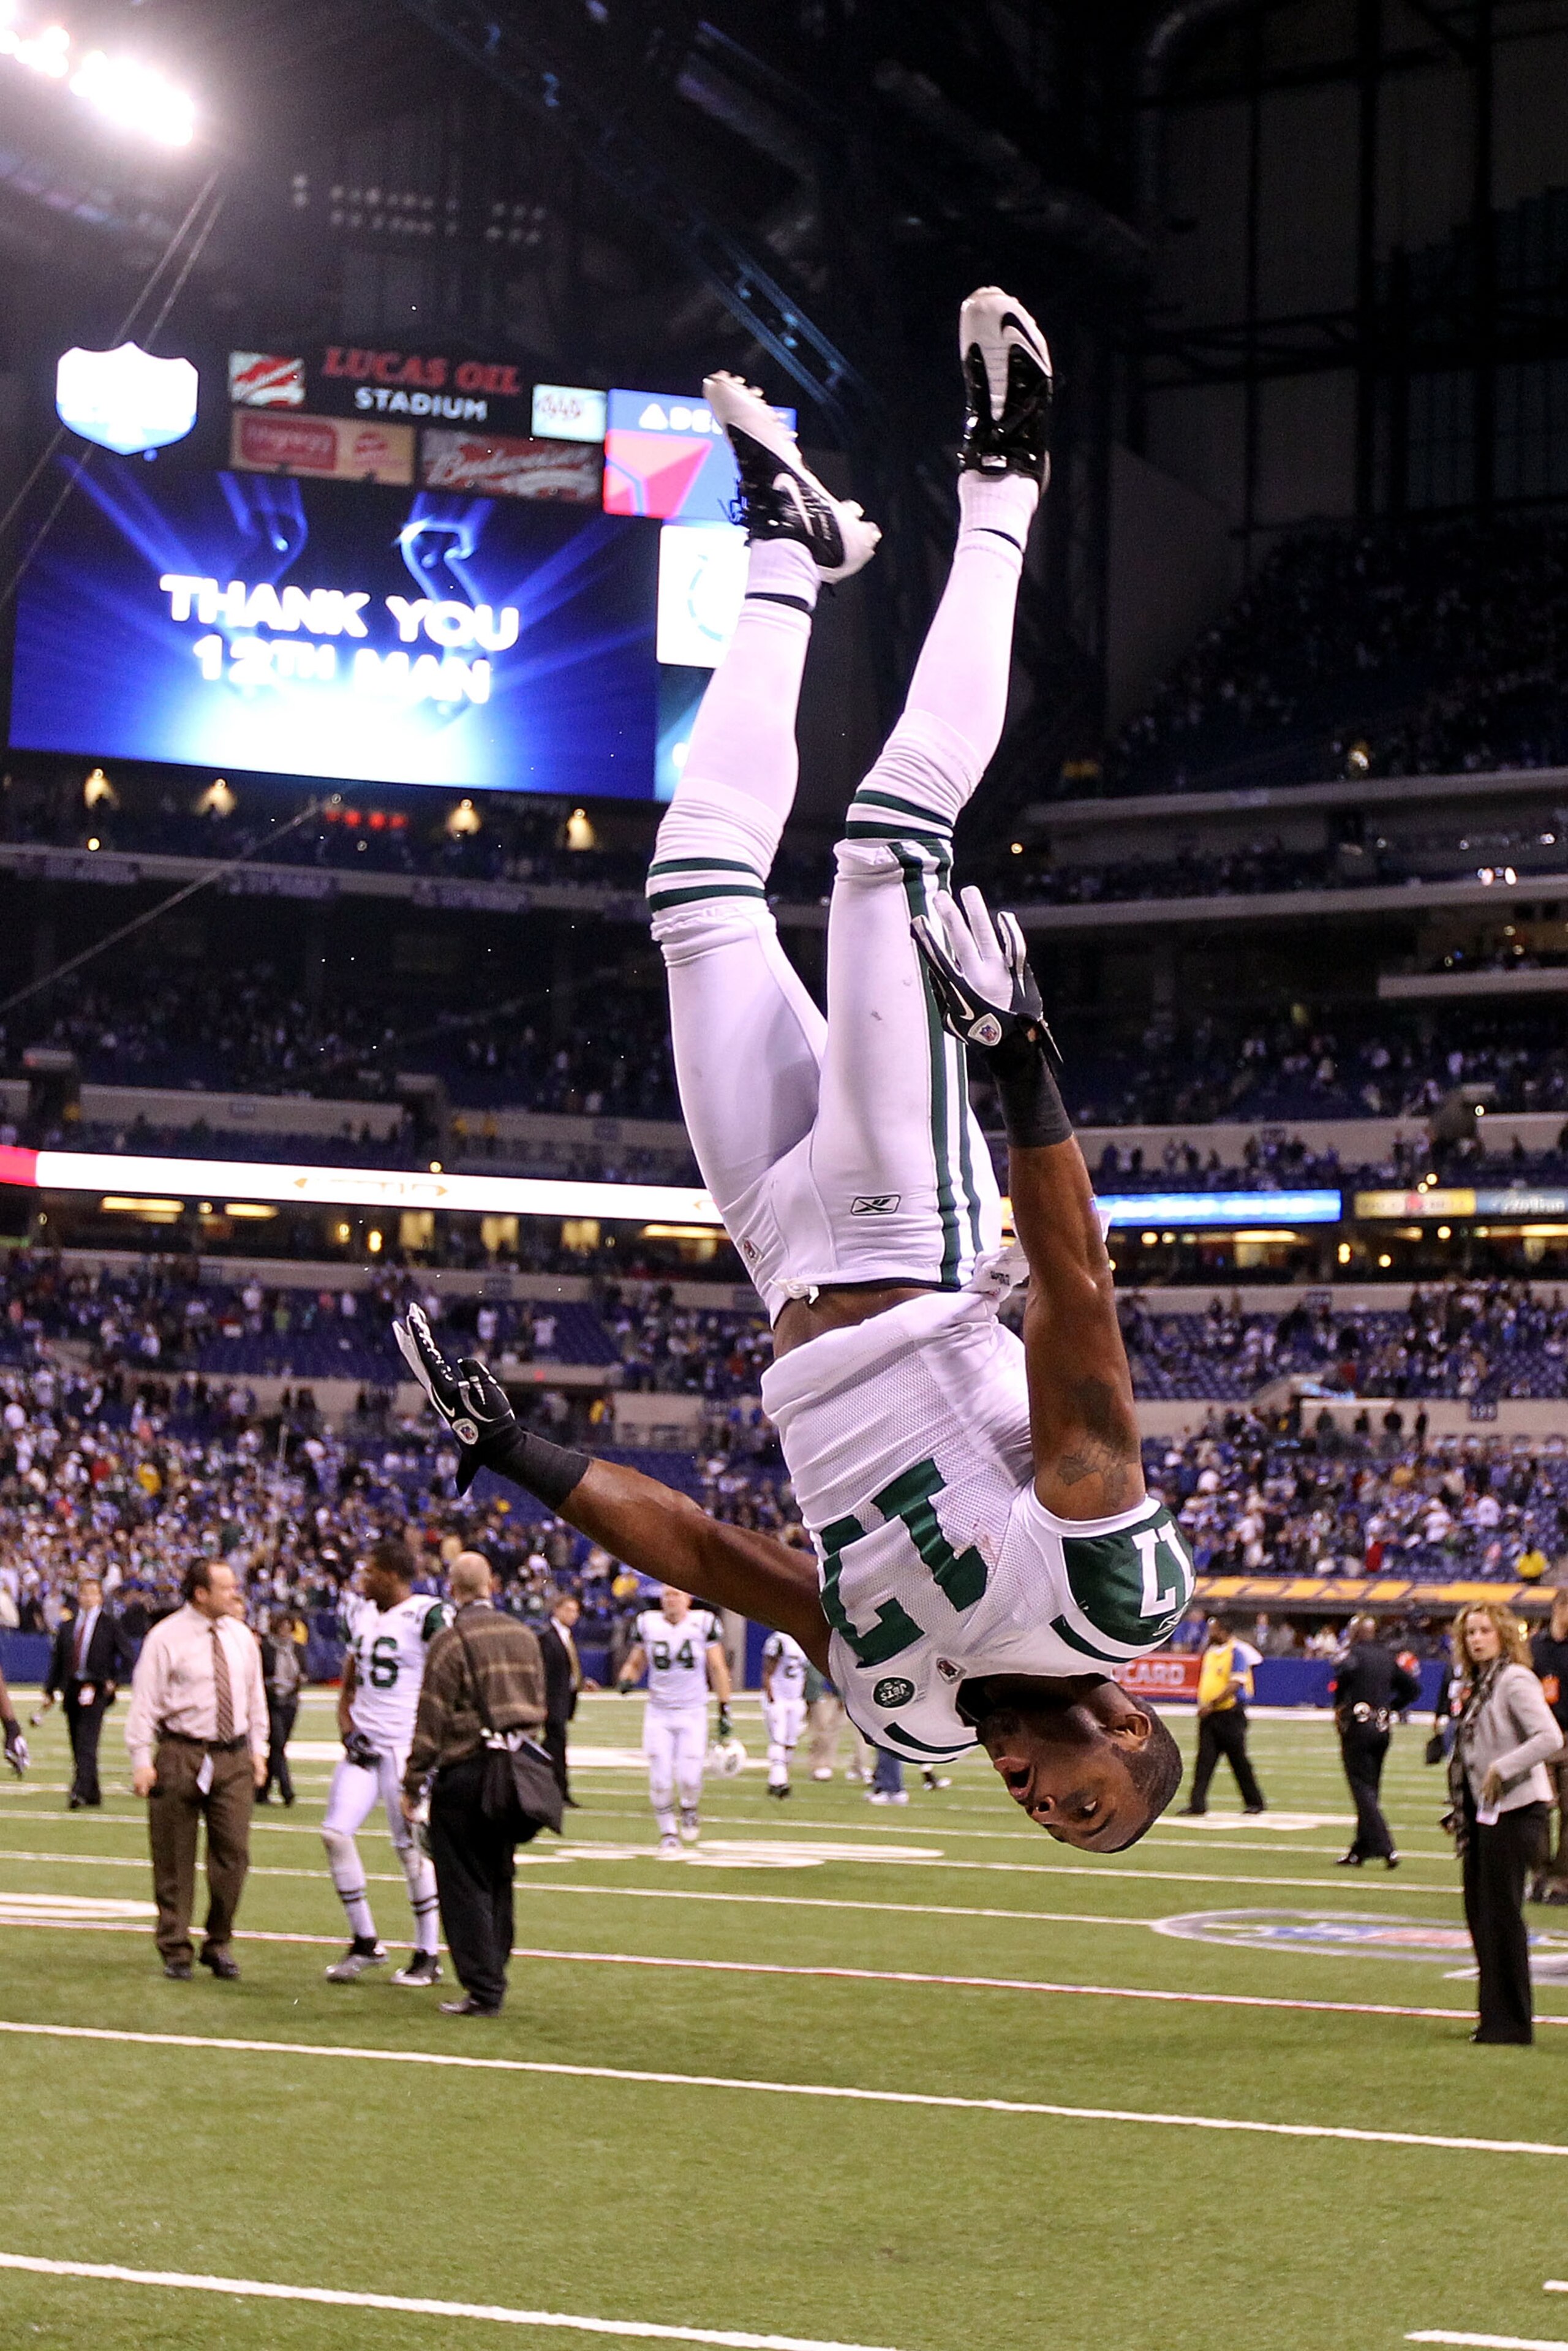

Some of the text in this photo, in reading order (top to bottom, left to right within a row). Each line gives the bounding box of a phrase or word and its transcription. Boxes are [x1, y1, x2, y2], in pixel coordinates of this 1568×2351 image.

[325, 346, 522, 397] LUCAS OIL
[354, 386, 488, 423] STADIUM
[159, 573, 519, 651] THANK YOU
[193, 634, 491, 704] 12TH MAN
[820, 1457, 989, 1669] 17
[651, 1639, 695, 1670] 84
[880, 1682, 908, 1702] JETS
